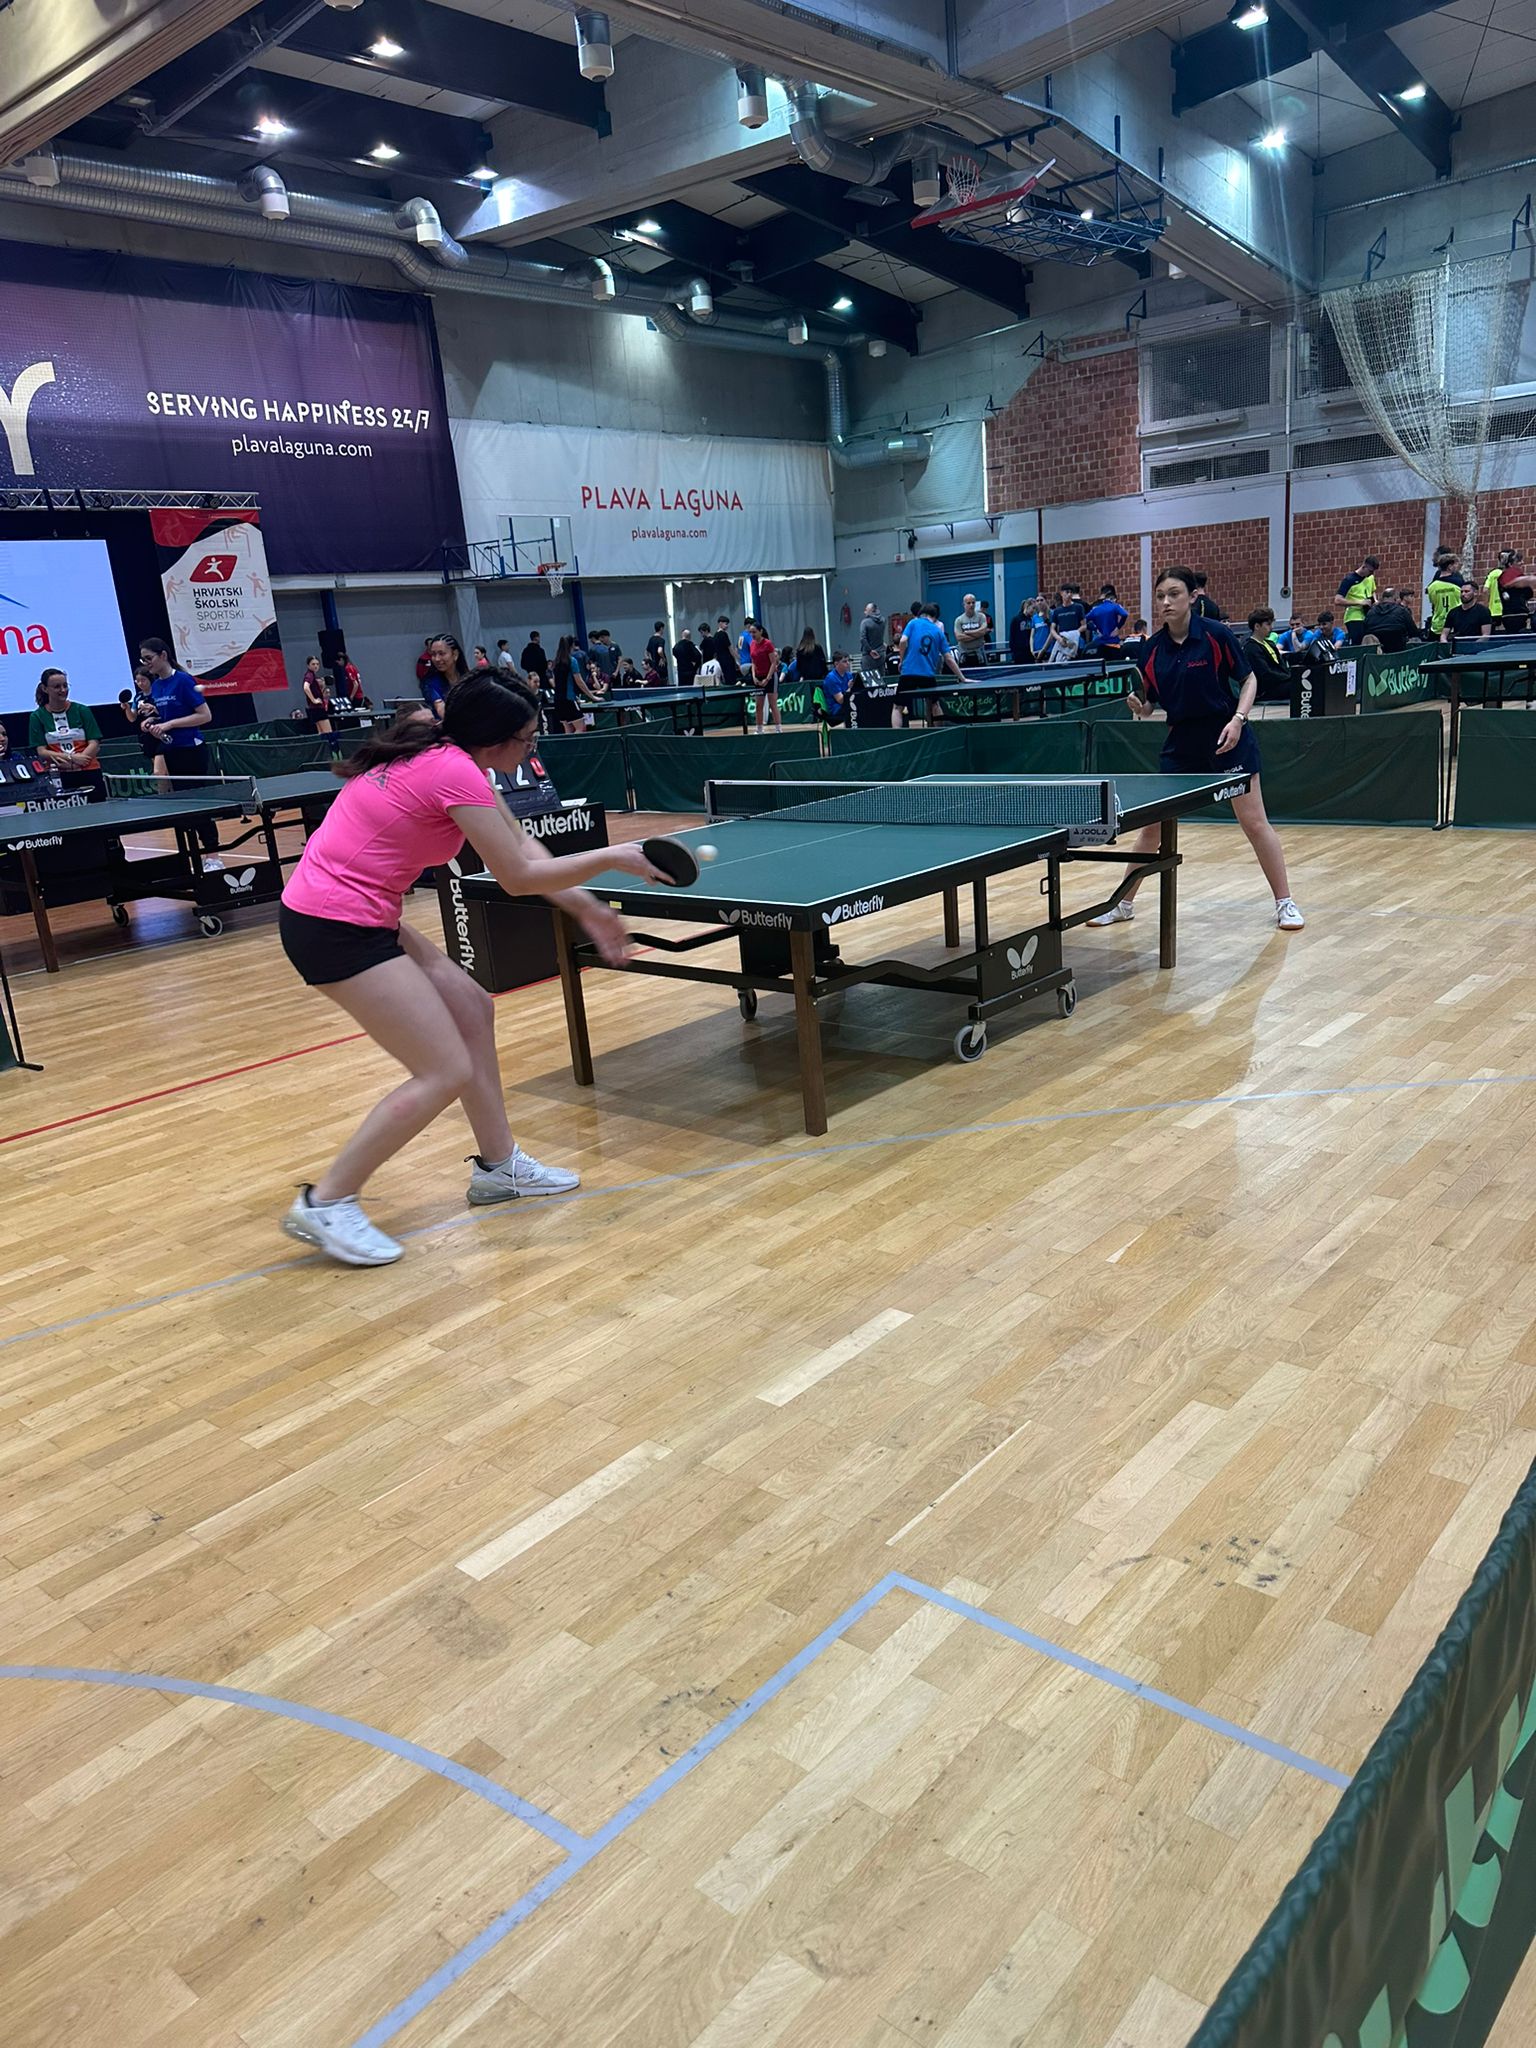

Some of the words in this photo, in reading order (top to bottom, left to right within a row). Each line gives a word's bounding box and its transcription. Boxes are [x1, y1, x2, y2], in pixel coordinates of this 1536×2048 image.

[146, 391, 258, 420] SERVING
[263, 399, 388, 428] HAPPINESS
[391, 407, 431, 434] 24/7
[231, 433, 373, 459] plavalaguna.com
[581, 486, 651, 509] PLAVA
[660, 488, 744, 518] LAGUNA
[631, 526, 708, 541] plavalaguna.com
[192, 587, 243, 598] HRVATSKI
[194, 598, 239, 609] ŠKOLSKI
[1442, 595, 1449, 612] 4
[196, 610, 245, 621] SPORTSKI
[198, 621, 231, 632] SAVEZ
[920, 635, 932, 656] 9
[705, 665, 715, 675] 14
[61, 743, 73, 752] 10
[27, 795, 88, 813] Butterfly
[522, 808, 591, 840] Butterfly
[25, 835, 63, 849] Butterfly
[842, 894, 884, 920] Butterfly
[449, 878, 476, 971] Butterfly
[742, 909, 793, 931] Butterfly
[1010, 964, 1034, 980] Butterfly
